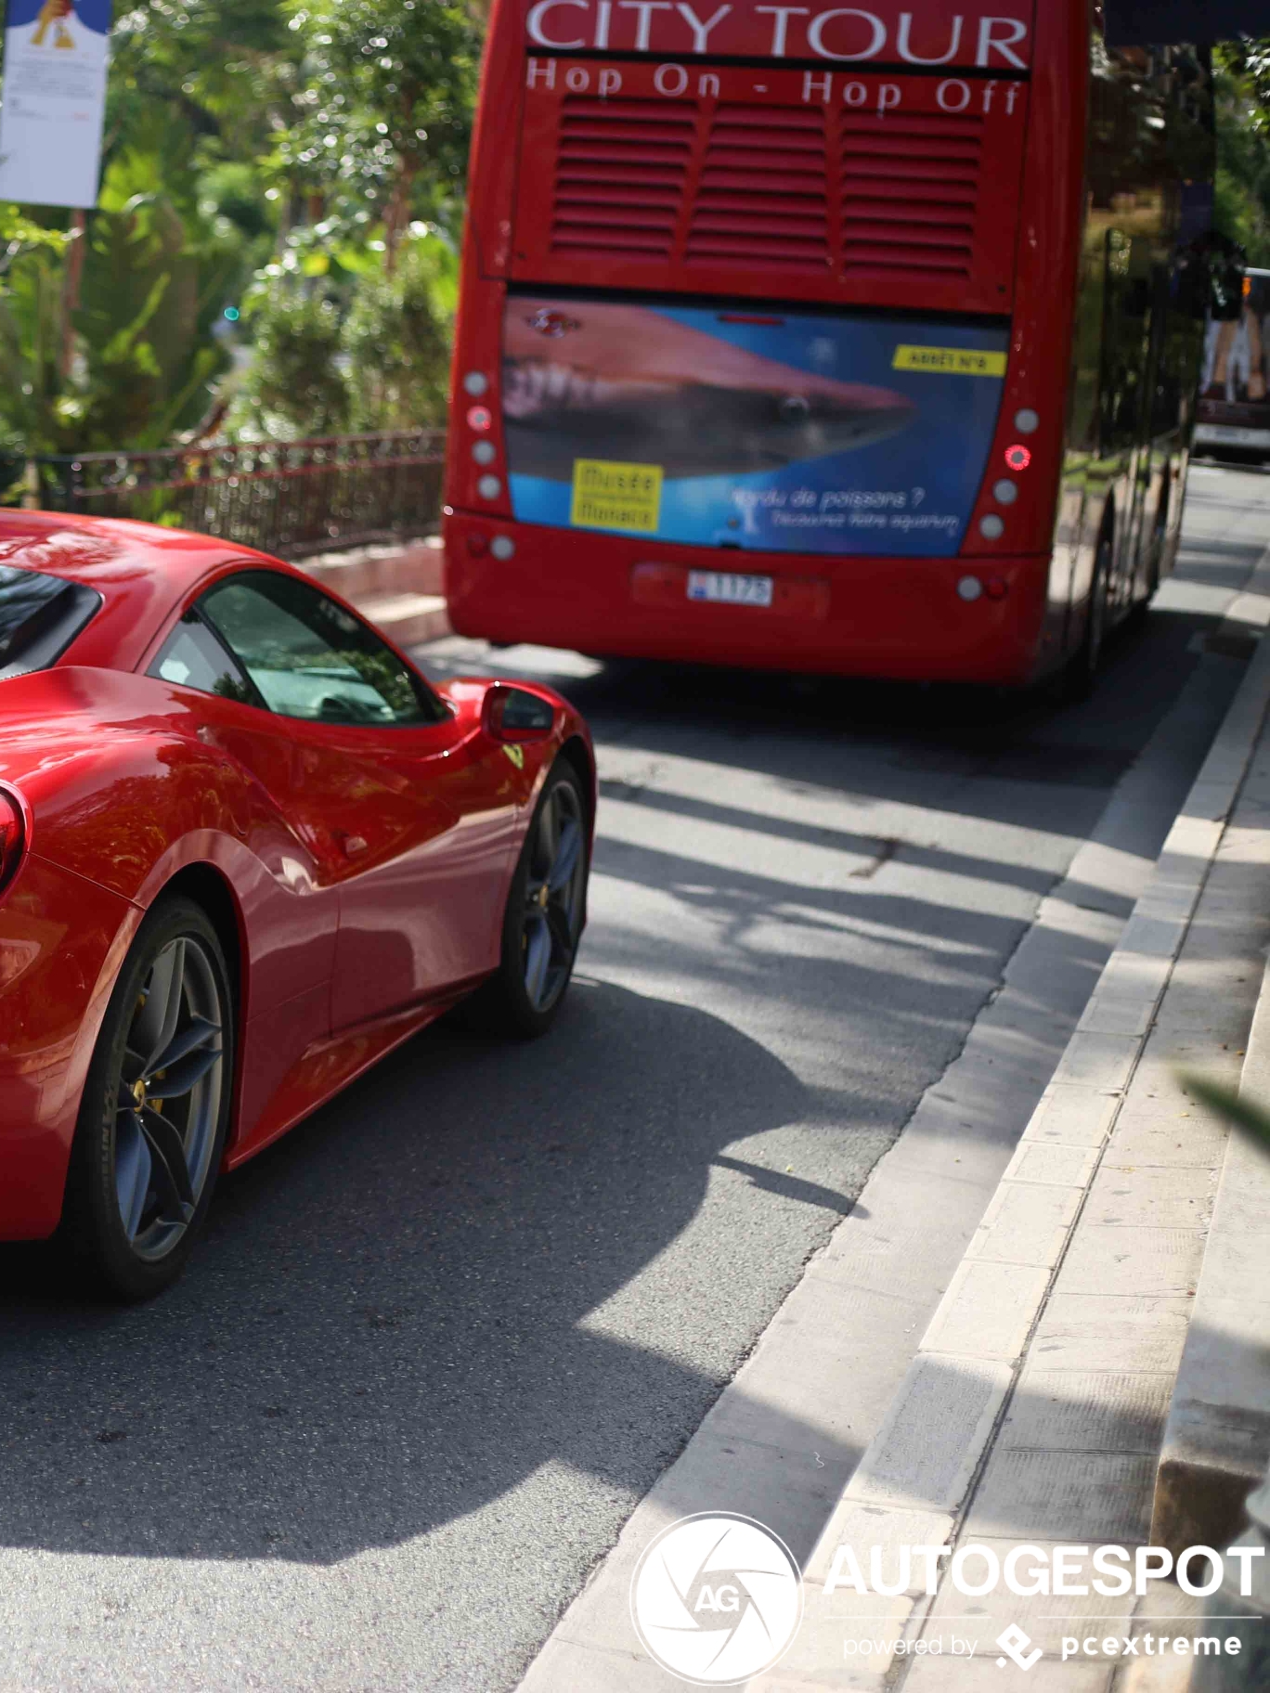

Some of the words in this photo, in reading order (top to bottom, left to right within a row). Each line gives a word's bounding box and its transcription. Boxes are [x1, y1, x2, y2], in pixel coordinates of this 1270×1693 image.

[526, 0, 731, 54] CITY
[755, 6, 1028, 69] TOUR
[526, 57, 622, 102] Hop
[653, 63, 720, 97] On
[802, 70, 902, 117] Hop
[936, 78, 1023, 115] Off
